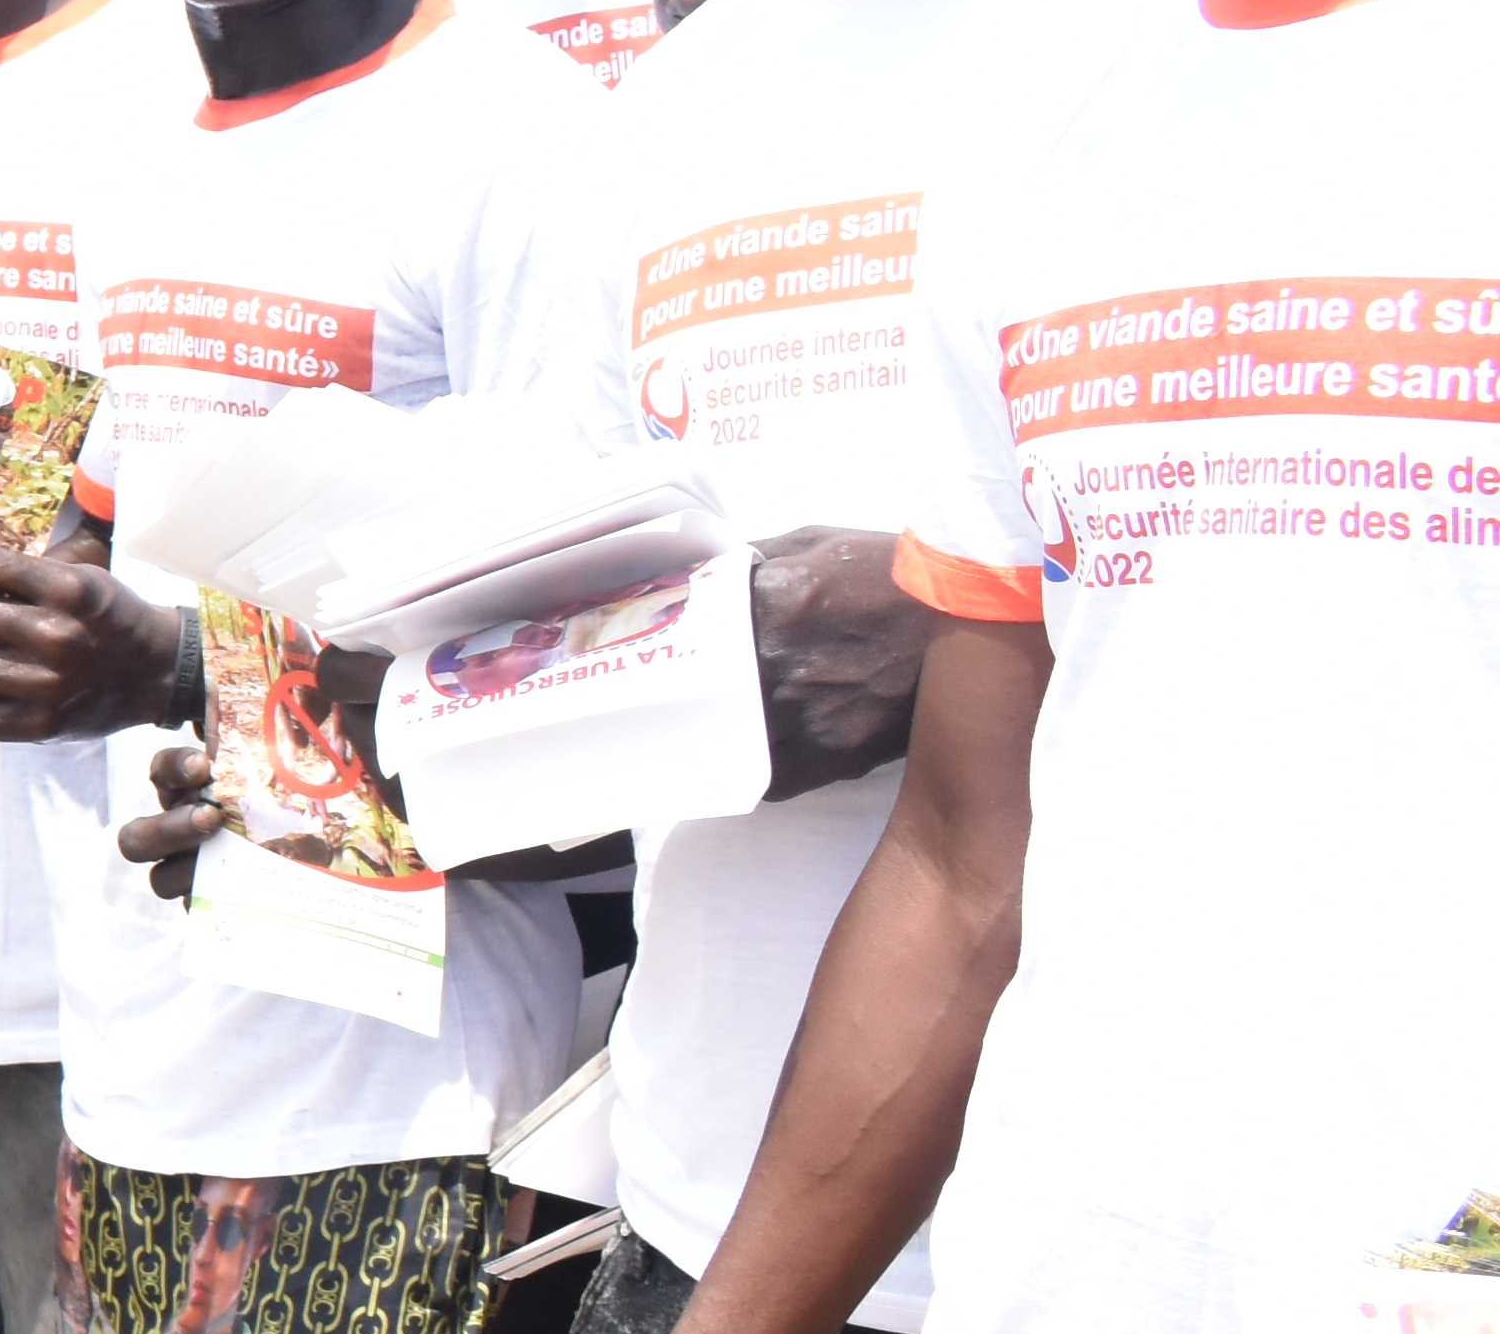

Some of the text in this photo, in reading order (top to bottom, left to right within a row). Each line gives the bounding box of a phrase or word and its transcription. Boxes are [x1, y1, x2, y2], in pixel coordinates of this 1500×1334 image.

[611, 9, 656, 39] sai
[23, 227, 48, 252] et
[648, 200, 918, 285] «Une viande sain
[27, 268, 75, 291] san
[641, 253, 915, 340] pour une meilleu
[115, 284, 170, 315] viande
[173, 289, 228, 321] saine
[233, 298, 259, 326] et
[265, 300, 338, 339] sûre
[1008, 289, 1500, 368] «Une viande saine et sû
[138, 327, 226, 363] meilleure
[233, 340, 340, 379] santé»
[704, 326, 905, 372] Journée interna
[706, 358, 905, 409] sécurité sanitai
[1010, 355, 1500, 438] pour une meilleure sant
[711, 414, 760, 446] 2022
[1075, 452, 1196, 496] Journée
[1203, 449, 1433, 491] internationale
[1087, 500, 1194, 542] sécurité
[1198, 500, 1326, 536] sanitaire
[1339, 502, 1410, 539] des
[1083, 550, 1154, 588] 2022
